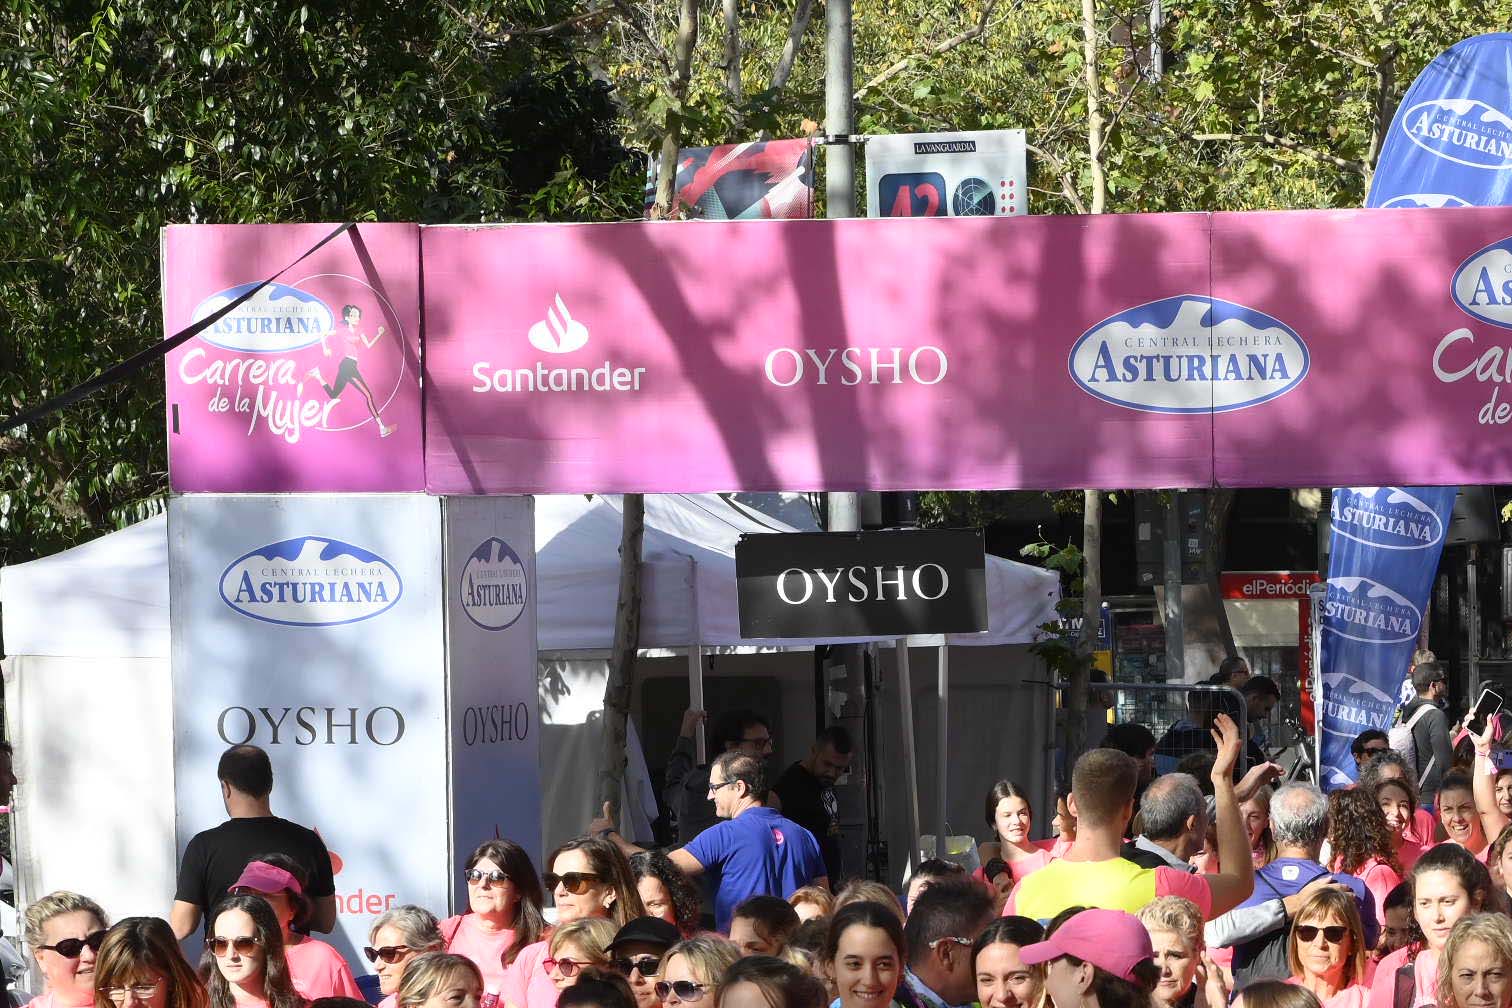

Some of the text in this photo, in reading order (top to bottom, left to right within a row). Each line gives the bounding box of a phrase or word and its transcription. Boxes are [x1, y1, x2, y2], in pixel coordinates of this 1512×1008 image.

[1087, 340, 1292, 383] ASTURIANA
[1124, 335, 1283, 348] CENTRAL LECHERA
[178, 347, 297, 386] Carrera
[472, 360, 646, 394] Santander
[764, 345, 949, 387] OYSHO
[208, 382, 341, 444] de la Mujer
[1478, 386, 1512, 425] de
[1330, 496, 1432, 542] ASTURIANA
[234, 569, 390, 604] ASTURIANA
[261, 567, 384, 577] CENTRAL LECHERA
[466, 569, 524, 608] ASTURIANA
[776, 562, 950, 605] OYSHO
[217, 705, 406, 746] OYSHO
[463, 702, 530, 746] OYSHO
